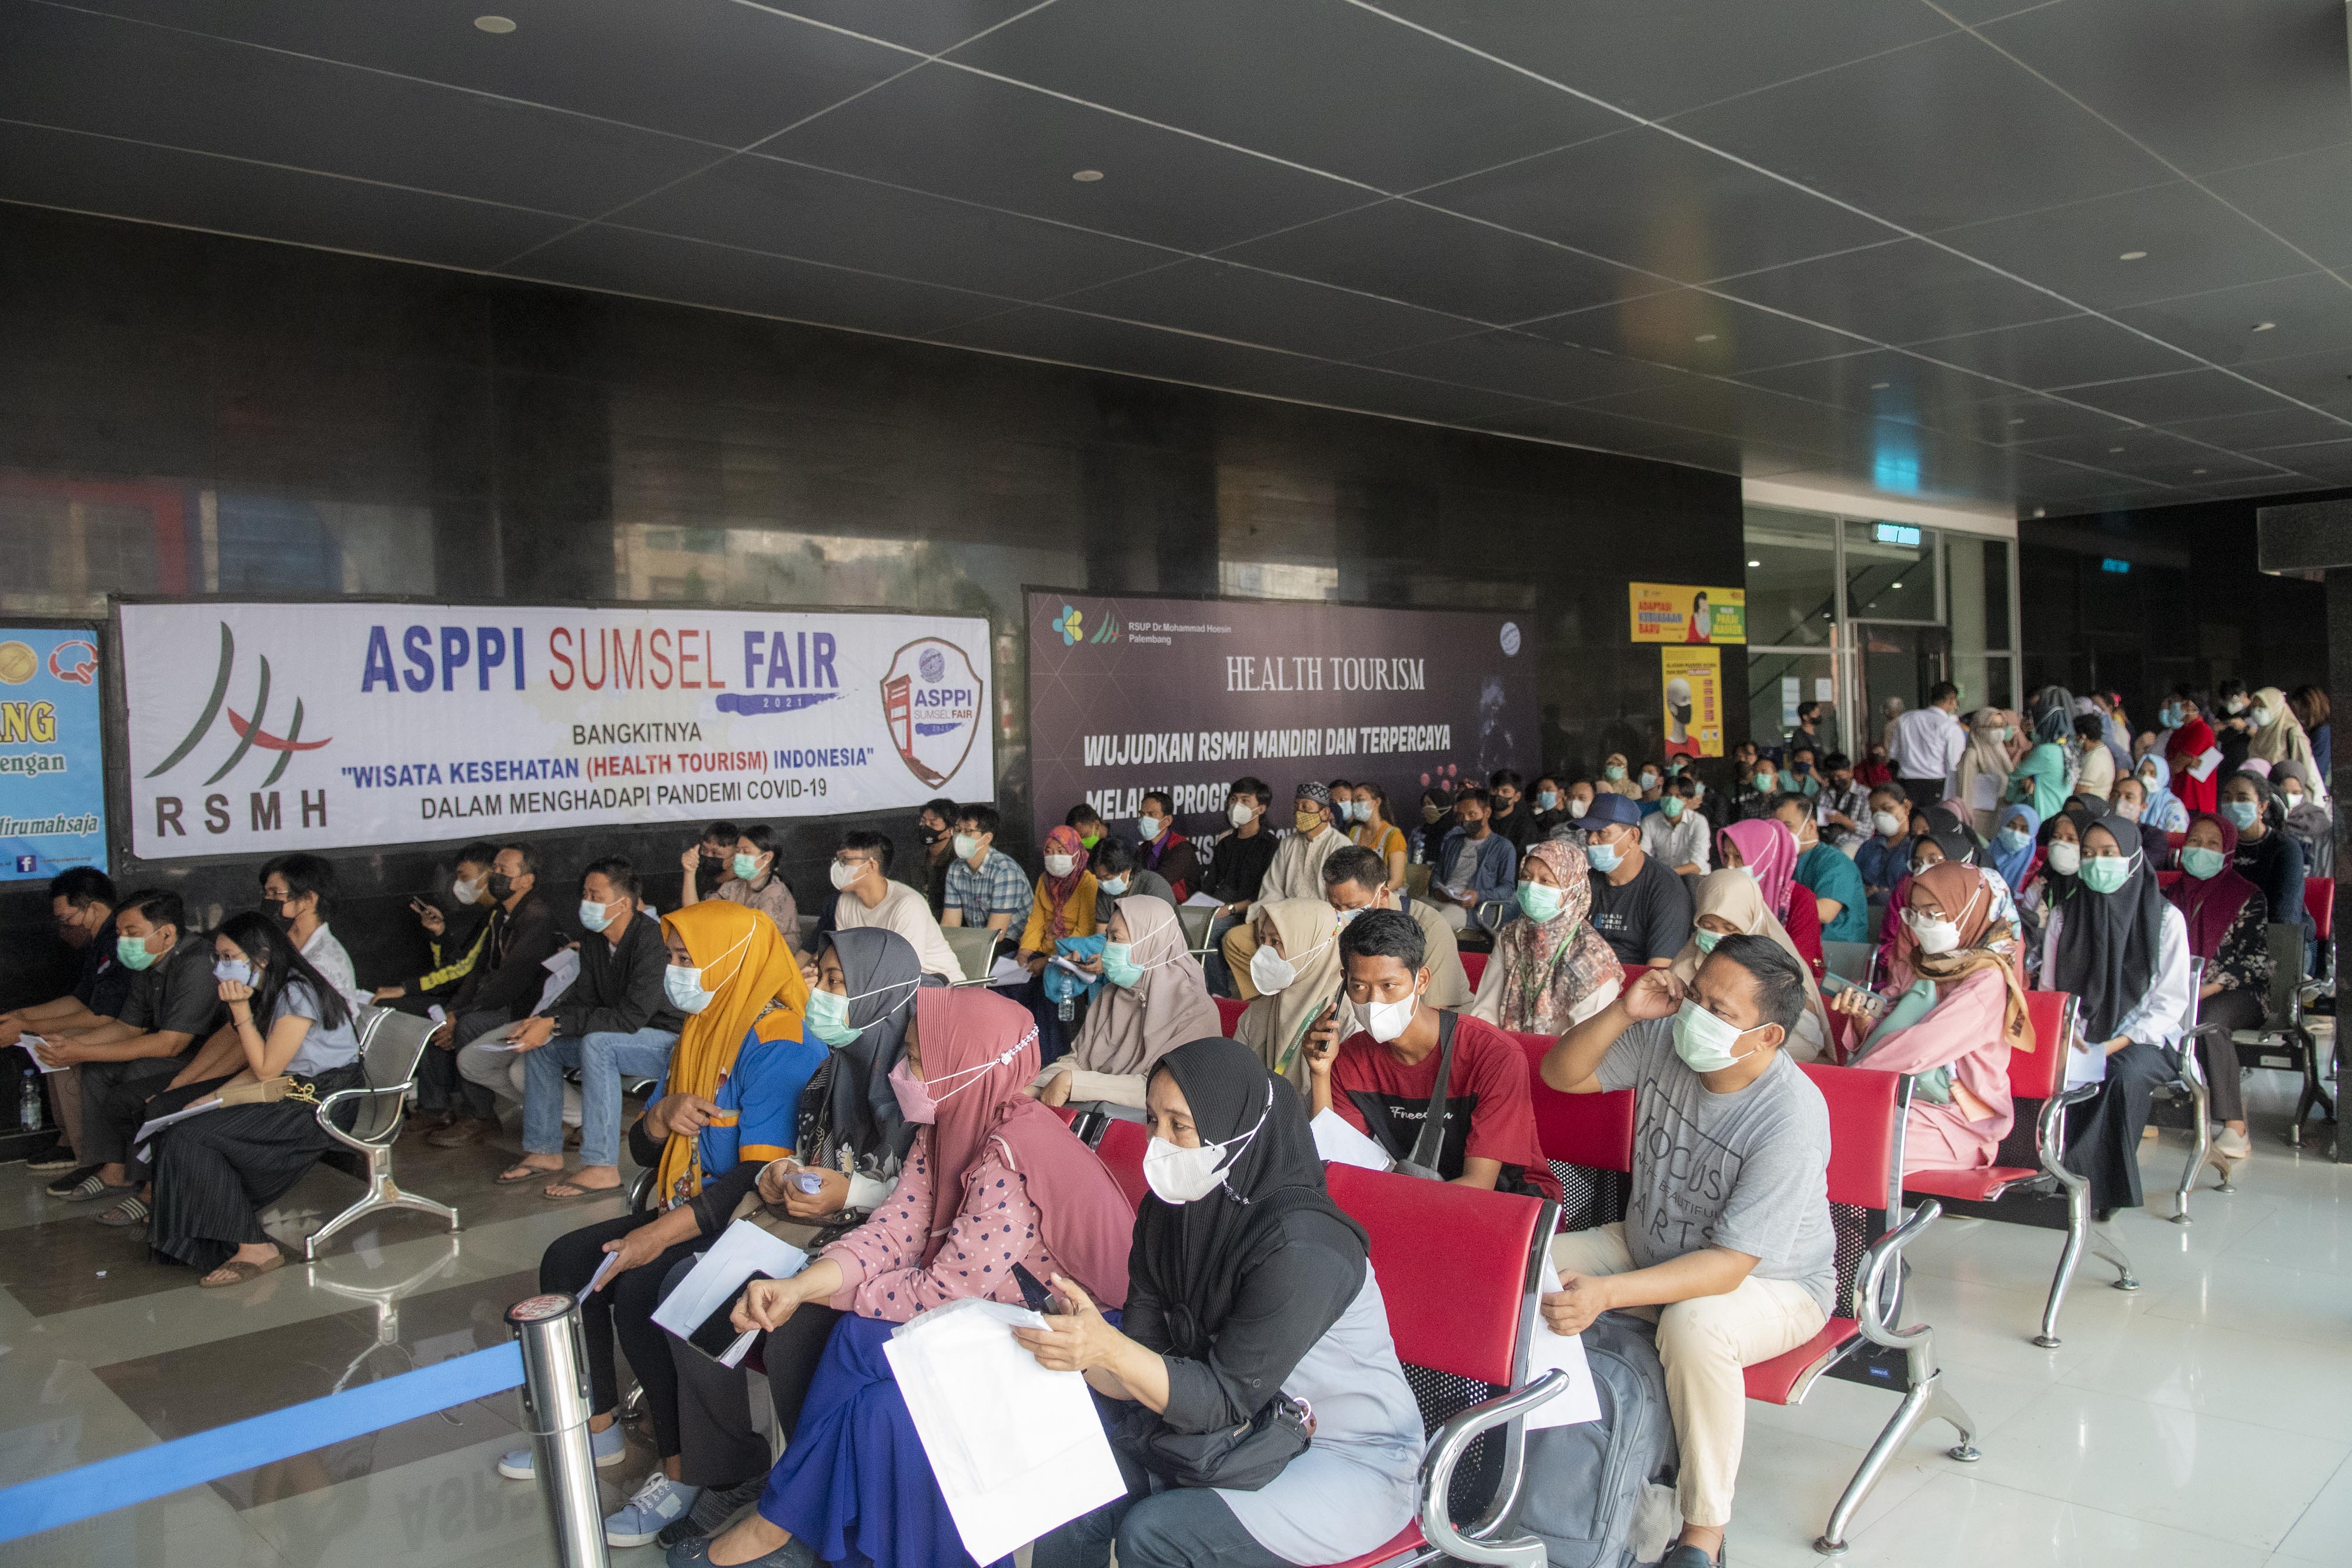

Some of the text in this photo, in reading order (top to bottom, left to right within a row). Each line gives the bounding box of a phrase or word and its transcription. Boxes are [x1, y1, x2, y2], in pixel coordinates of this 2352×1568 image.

[1128, 623, 1151, 631] RSUP
[1207, 625, 1232, 633] Hoesin
[1128, 634, 1172, 646] Palembang
[362, 625, 838, 693] ASPPI SUMSEL FAIR
[1227, 656, 1425, 691] HEALTH TOURISM
[763, 697, 801, 708] 2021
[914, 689, 972, 707] ASPPI
[914, 710, 973, 720] SUMSEL FAIR
[0, 701, 56, 743] NG
[573, 722, 701, 745] BANGKITNYA
[1084, 725, 1450, 767] WUJUDKAN RSMH MANDIRI DAN TERPERCAYA
[450, 758, 579, 784] KESEHATAN
[587, 754, 671, 783] (HEALTH
[677, 751, 767, 774] TOURISM)
[774, 747, 874, 769] INDONESIA"
[155, 789, 326, 838] RSMH
[422, 778, 827, 820] DALAM MENGHADAPI PANDEMI COVID-19
